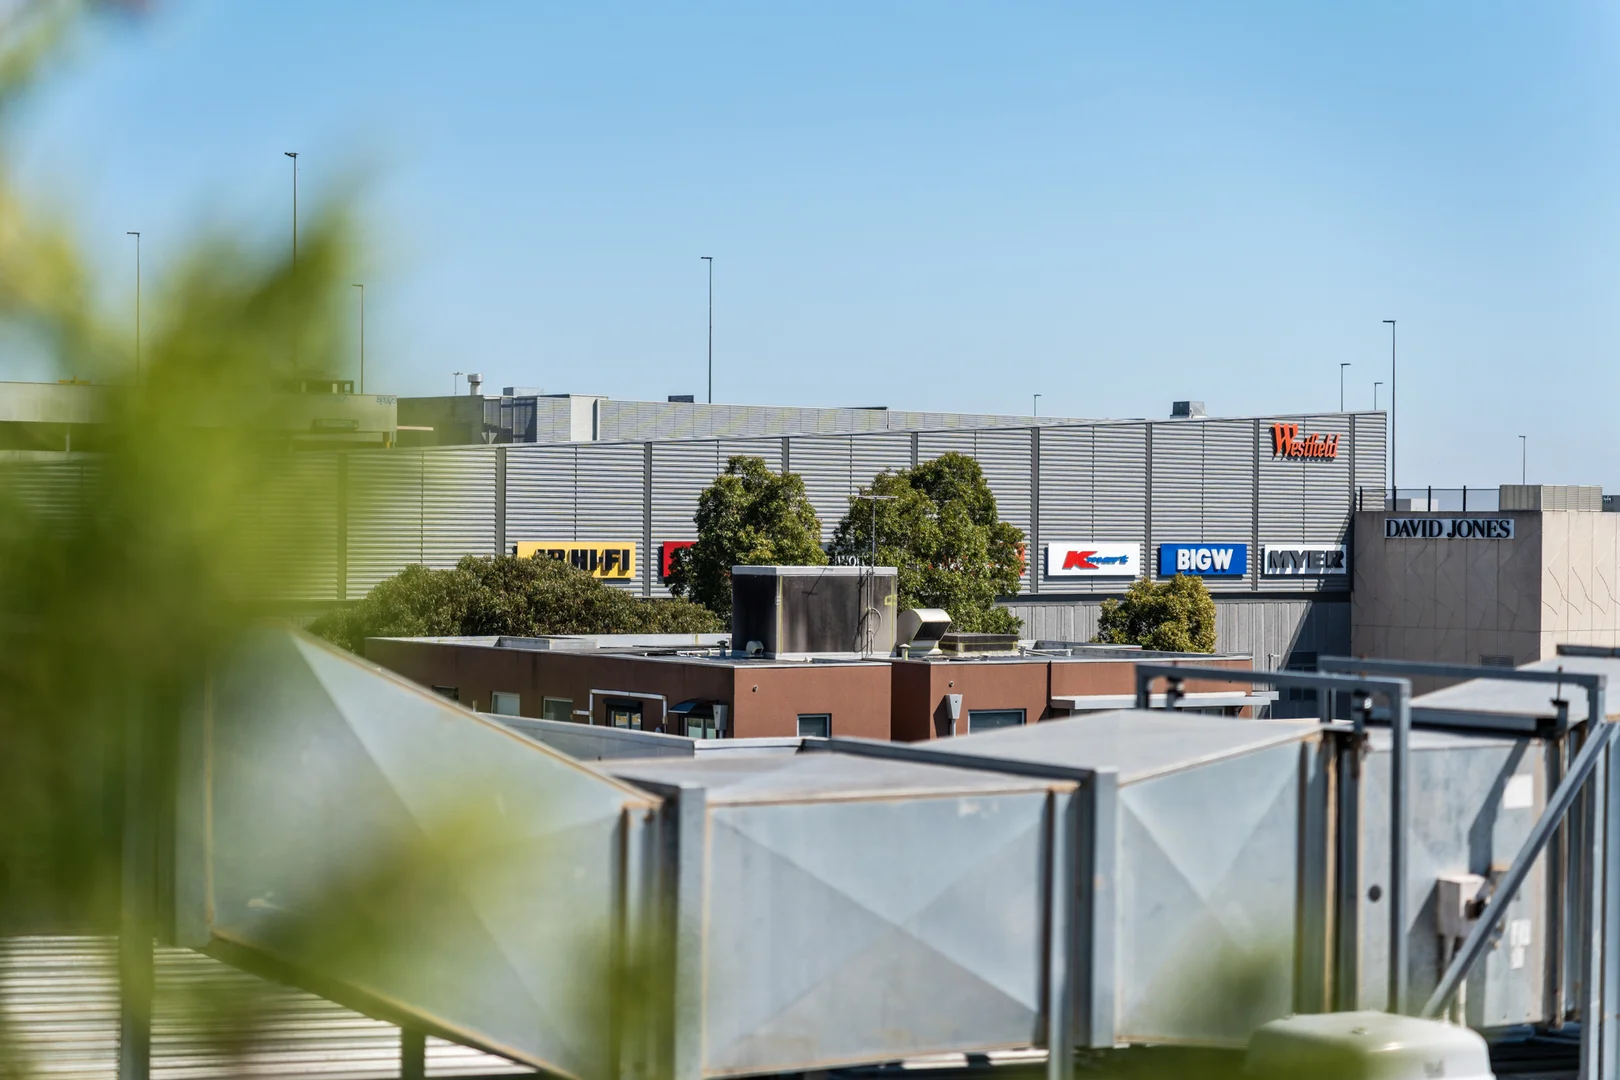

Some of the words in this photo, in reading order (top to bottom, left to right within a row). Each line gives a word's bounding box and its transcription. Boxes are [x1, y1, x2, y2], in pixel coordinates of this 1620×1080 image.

[1272, 422, 1341, 458] Westfield
[1385, 519, 1443, 537] DAVID
[1446, 519, 1510, 538] JONES
[569, 549, 630, 571] HI-FI
[1062, 551, 1129, 570] Kmart
[1268, 550, 1345, 569] MYER
